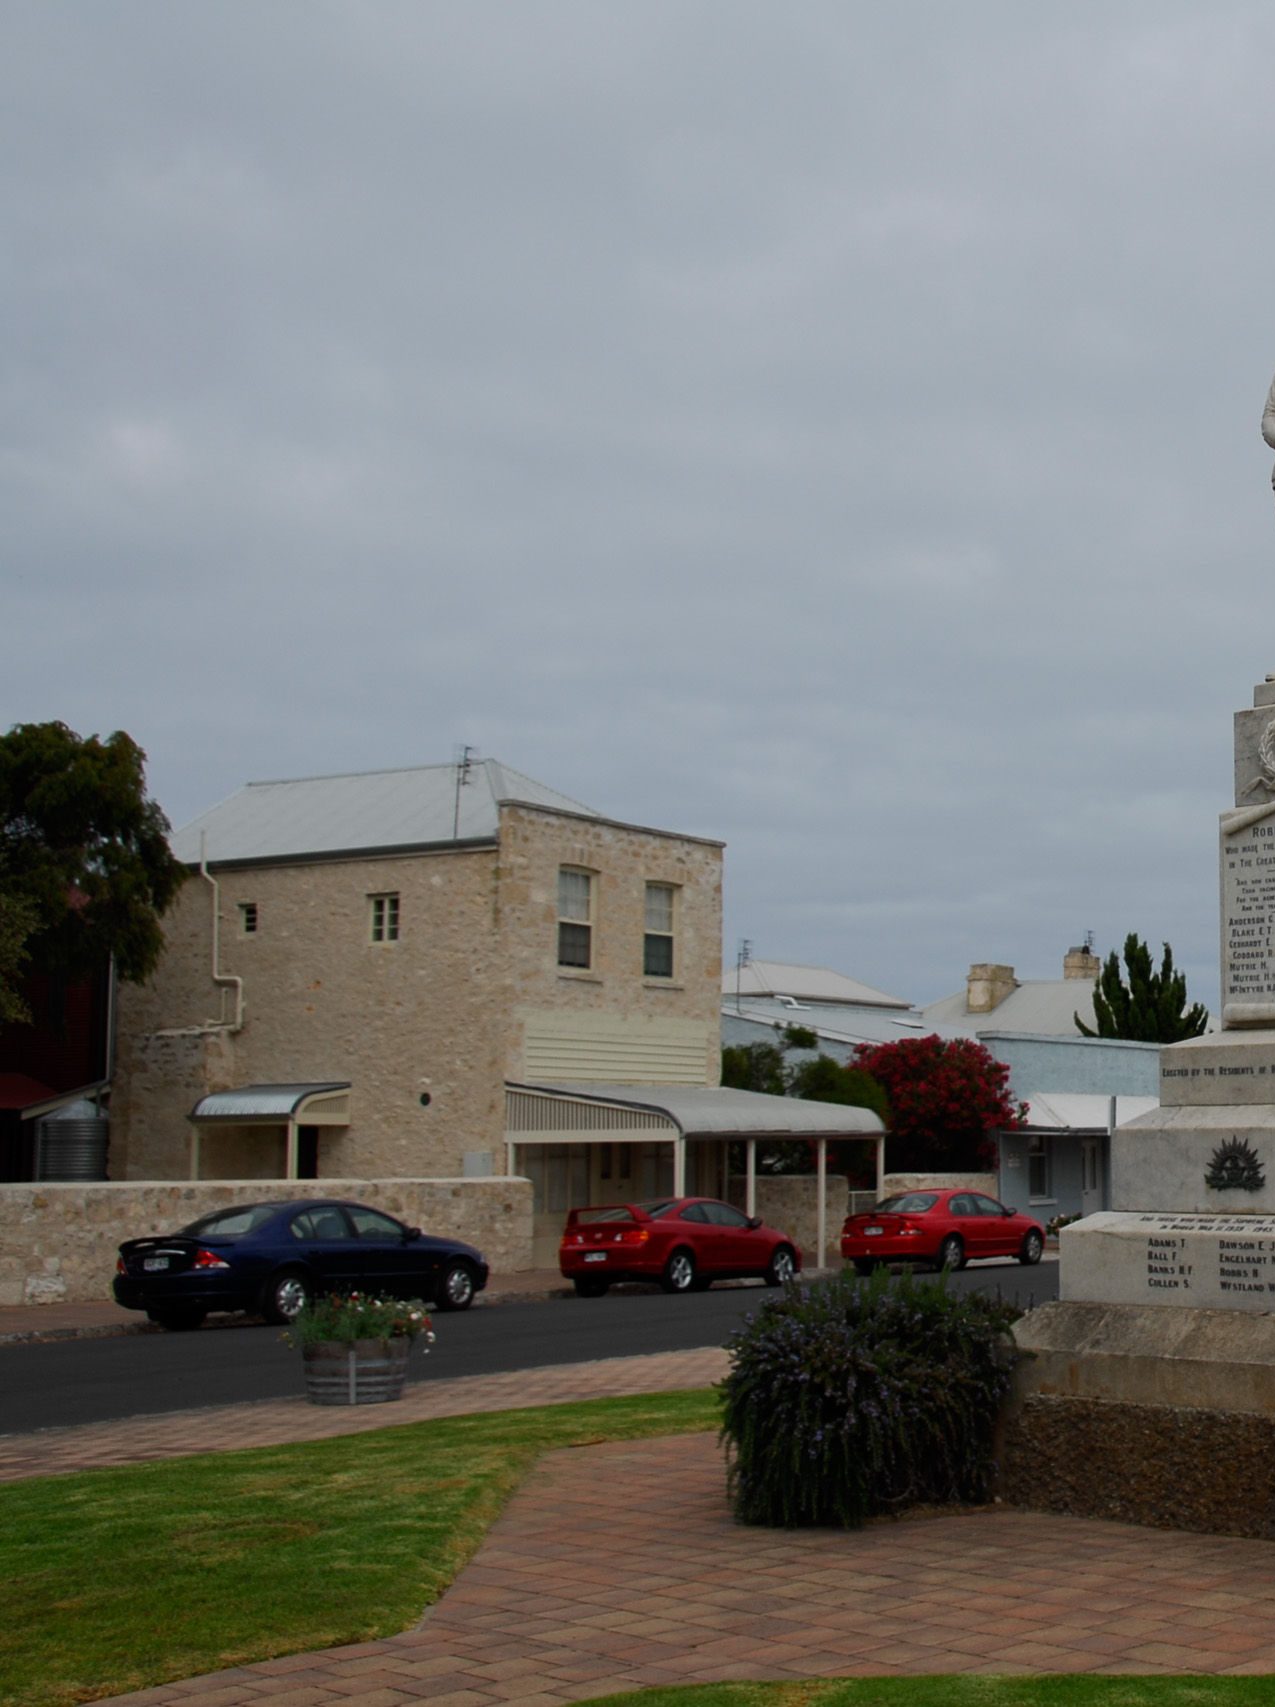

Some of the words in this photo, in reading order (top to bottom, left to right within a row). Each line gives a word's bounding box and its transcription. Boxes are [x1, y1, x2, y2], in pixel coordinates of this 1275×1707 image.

[1225, 847, 1239, 855] WHO
[1242, 844, 1258, 854] MADE
[1240, 858, 1252, 868] THE
[1256, 857, 1275, 866] GREAT
[1229, 917, 1265, 926] ANDERSON
[1232, 929, 1255, 937] BLAKE
[1230, 963, 1256, 972] MUTRIE
[1232, 974, 1260, 982] MUTRIE
[1162, 1068, 1188, 1077] ERECTED
[1191, 1068, 1200, 1076] BY
[1204, 1068, 1215, 1076] THE
[1219, 1066, 1254, 1075] RESIDENTS
[1258, 1066, 1266, 1074] OF
[1148, 1238, 1177, 1248] ADAMS
[1219, 1240, 1255, 1250] DAWSON
[1148, 1251, 1168, 1261] BALL
[1148, 1264, 1175, 1274] BANKS
[1220, 1267, 1248, 1278] HOBBS
[1148, 1278, 1179, 1288] CULLEN
[1220, 1281, 1264, 1292] WESTLAND
